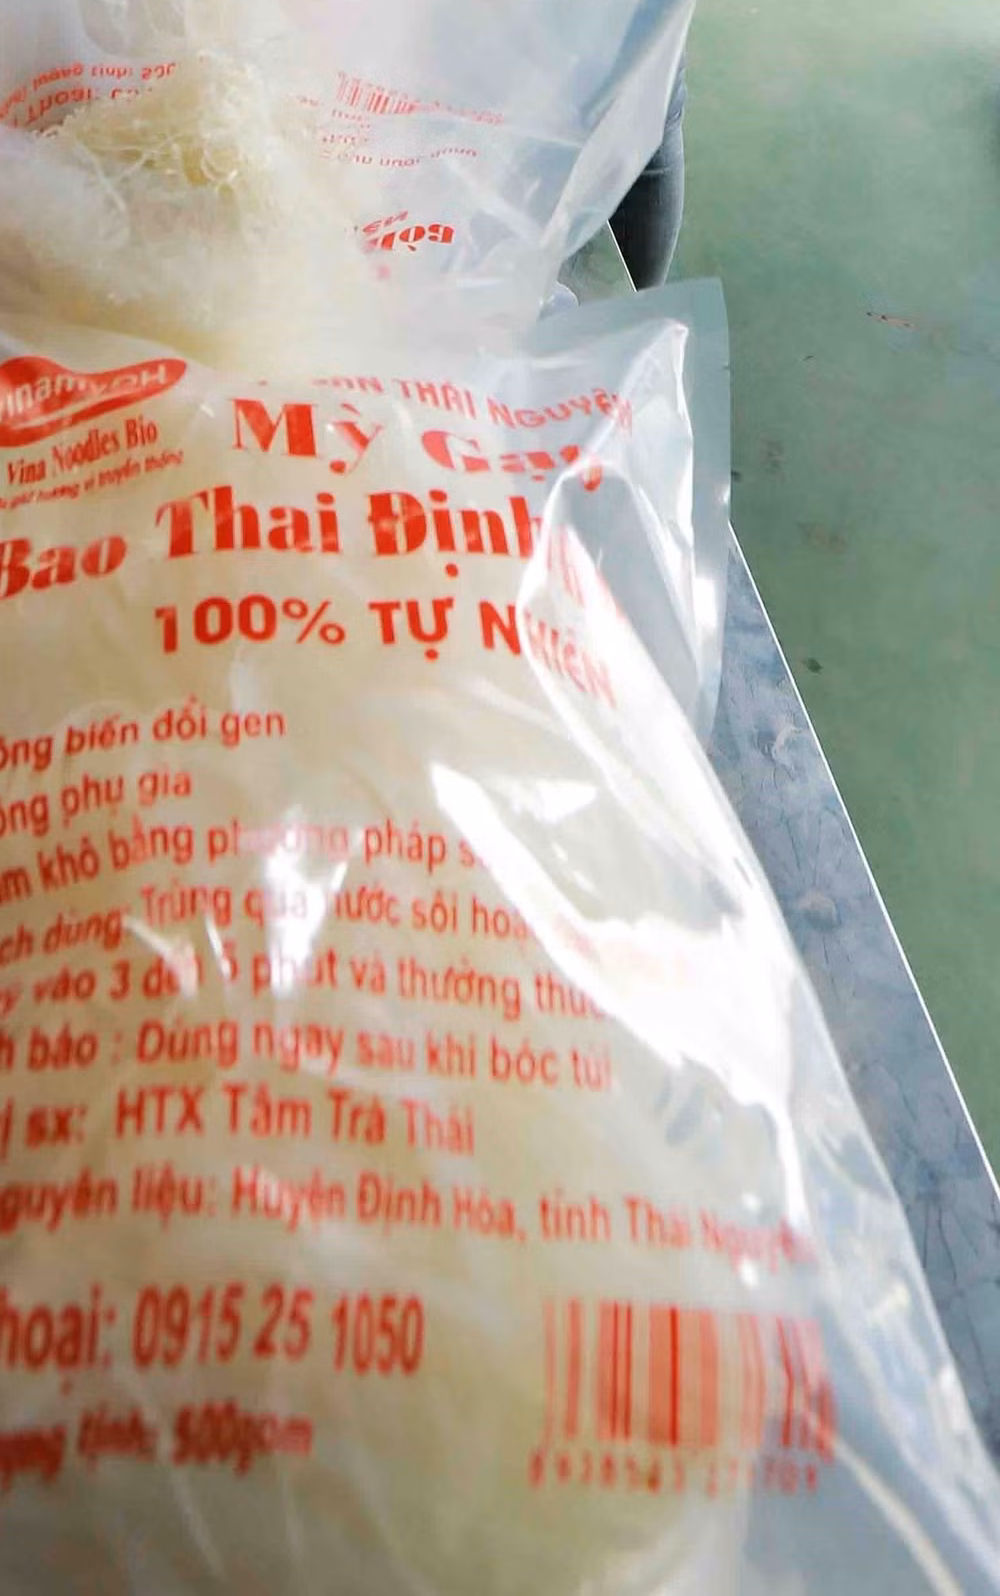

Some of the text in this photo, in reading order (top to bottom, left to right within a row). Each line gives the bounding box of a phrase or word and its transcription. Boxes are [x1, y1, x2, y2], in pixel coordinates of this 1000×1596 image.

[124, 414, 159, 450] Bio
[229, 398, 384, 476] Mỳ
[155, 484, 341, 560] Thai
[154, 593, 346, 655] 100%
[369, 597, 455, 662] TỰ
[64, 713, 139, 757] biến
[152, 694, 208, 742] đổi
[220, 709, 287, 747] gen
[60, 772, 125, 828] phụ
[138, 769, 194, 806] gia
[37, 835, 100, 893] khô
[108, 813, 195, 872] bằng
[363, 817, 447, 874] pháp
[411, 891, 460, 933] sôi
[32, 961, 97, 1004] vào
[110, 959, 130, 1001] 3
[348, 954, 386, 995] và
[27, 1021, 99, 1071] báo
[136, 1013, 240, 1069] Dùng
[252, 1020, 345, 1075] ngay
[356, 1029, 416, 1070] sau
[425, 1029, 478, 1079] khi
[488, 1035, 560, 1085] bóc
[570, 1042, 612, 1092] túi
[115, 1086, 206, 1139] HTX
[222, 1080, 313, 1140] Tâm
[328, 1086, 388, 1147] Trà
[401, 1097, 476, 1157] Thái
[356, 1169, 442, 1237] Định
[131, 1281, 246, 1373] 0915
[253, 1282, 316, 1364] 25
[331, 1287, 427, 1377] 1050
